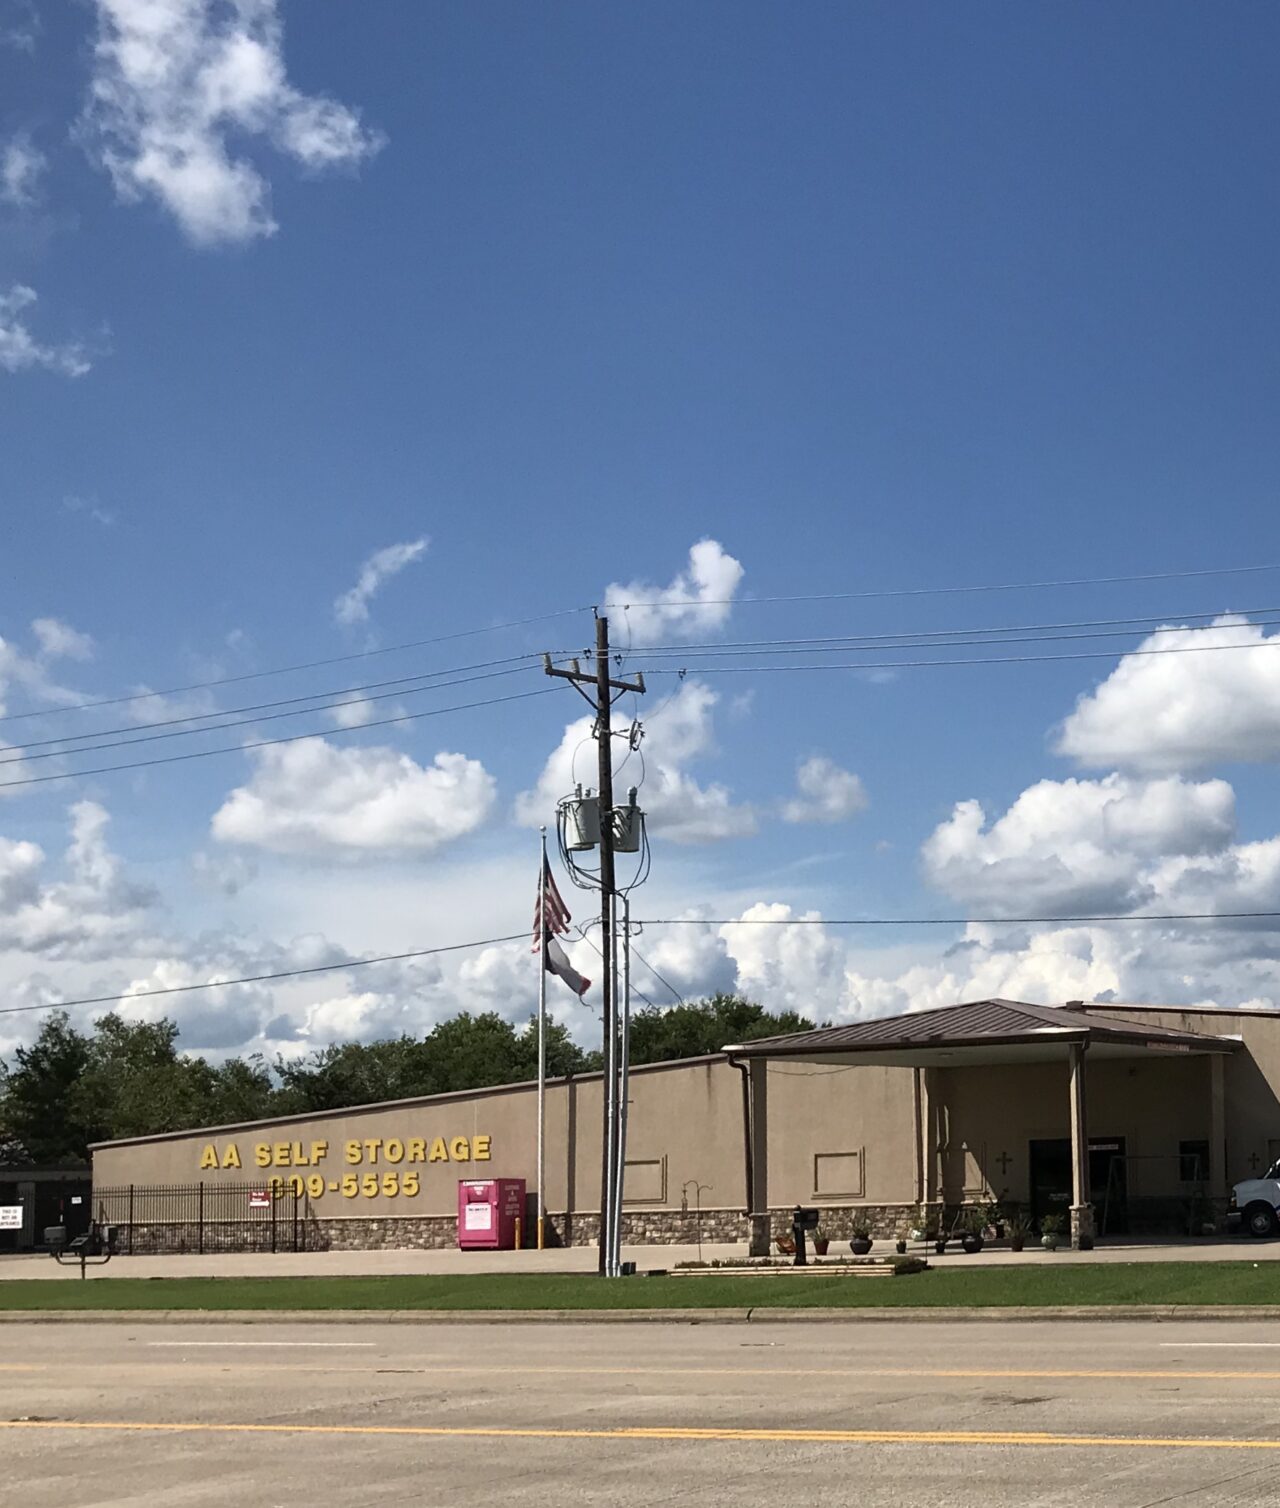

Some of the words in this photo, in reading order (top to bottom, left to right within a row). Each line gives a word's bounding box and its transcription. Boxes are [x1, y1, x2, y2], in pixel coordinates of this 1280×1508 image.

[200, 1143, 242, 1169] AA
[255, 1141, 329, 1167] SELF
[345, 1135, 492, 1165] STORAGE
